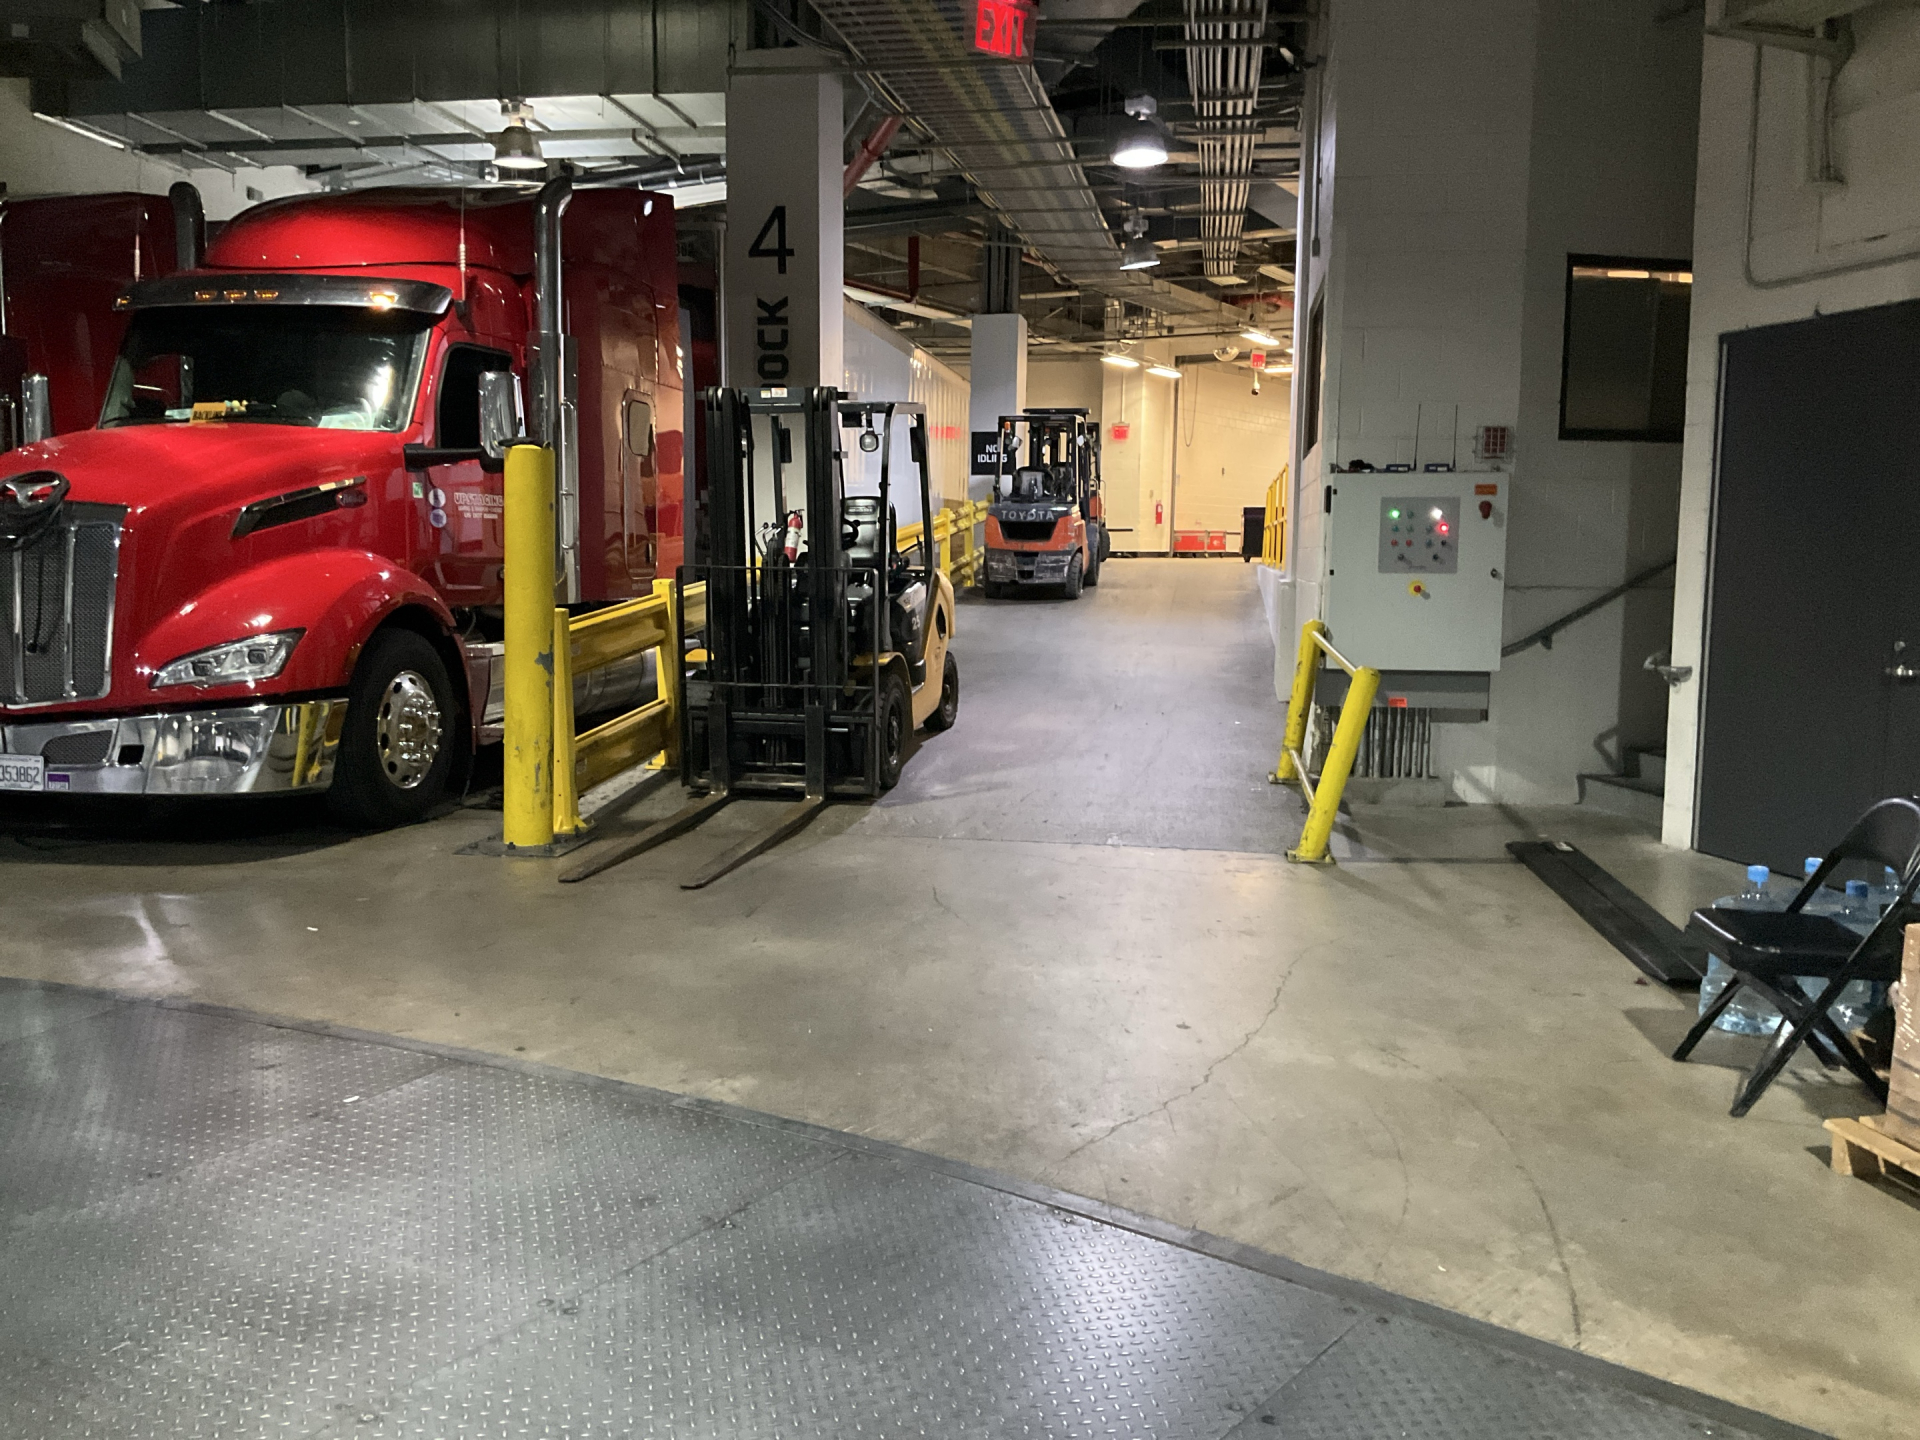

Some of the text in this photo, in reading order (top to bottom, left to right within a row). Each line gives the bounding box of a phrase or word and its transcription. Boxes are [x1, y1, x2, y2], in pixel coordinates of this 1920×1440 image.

[975, 0, 1028, 57] EXIT
[748, 206, 795, 274] 4
[757, 296, 789, 388] OCK
[977, 454, 1008, 463] IDLIG
[1001, 510, 1055, 520] TOYOTA
